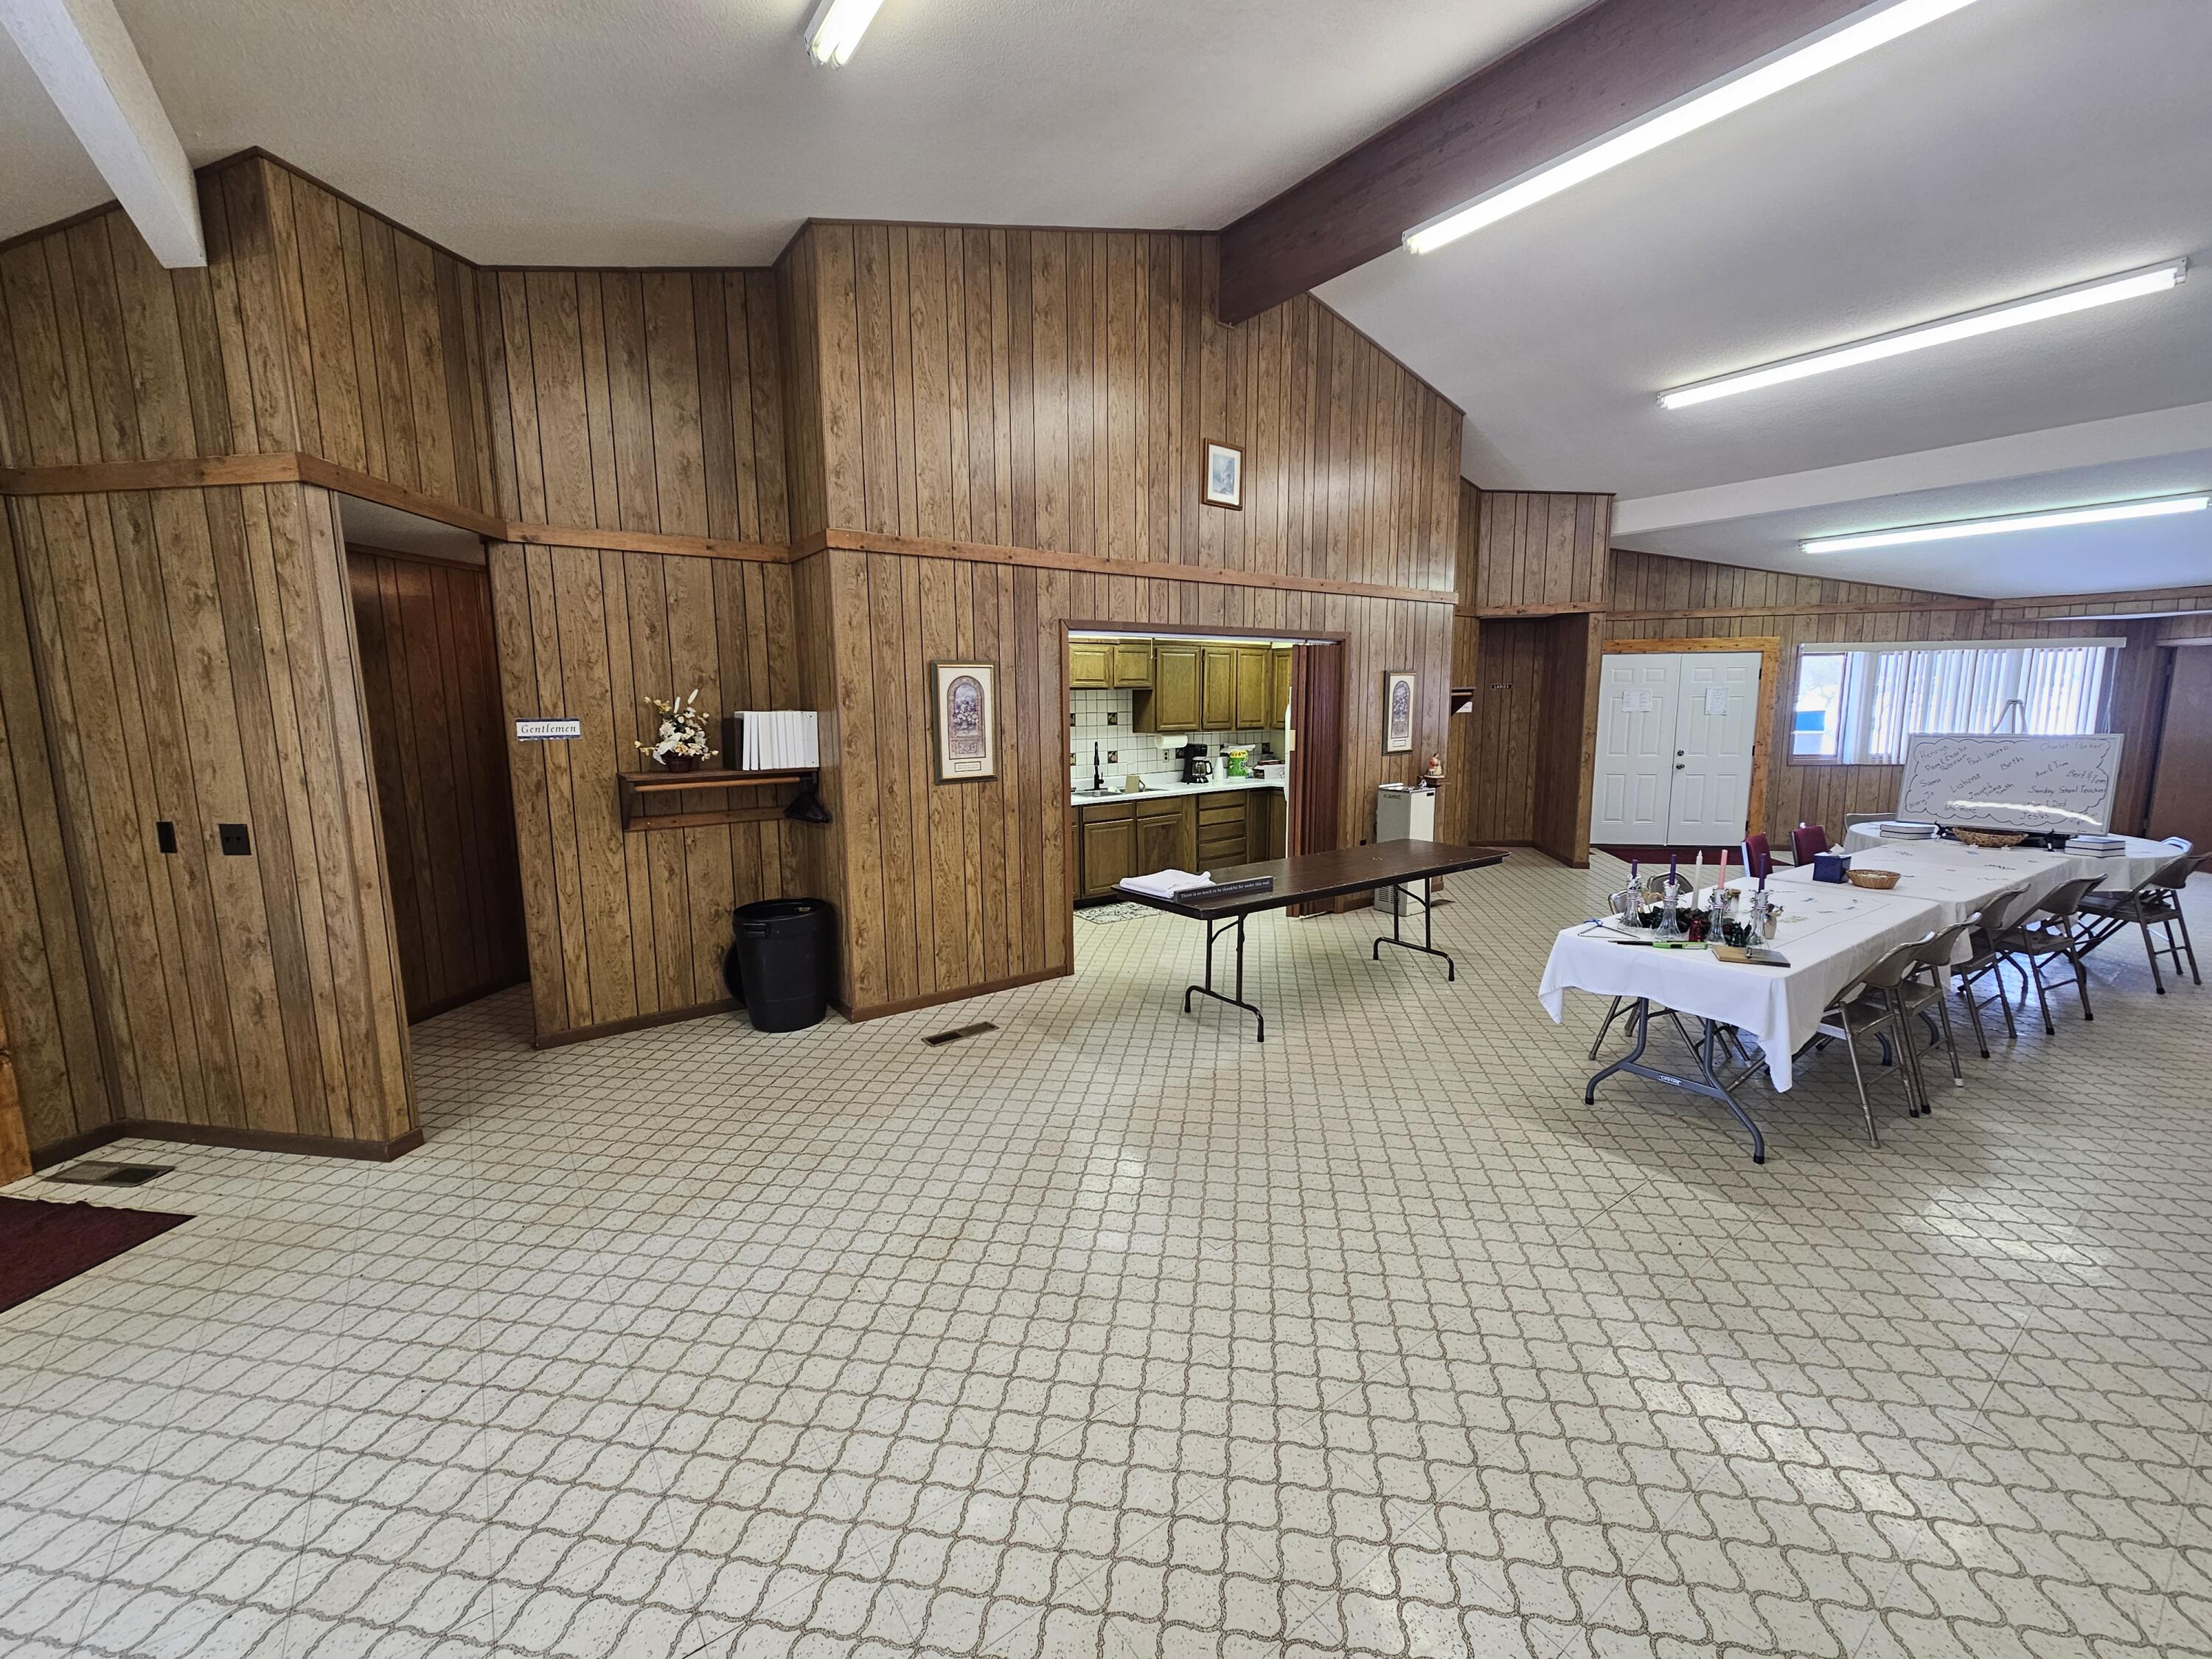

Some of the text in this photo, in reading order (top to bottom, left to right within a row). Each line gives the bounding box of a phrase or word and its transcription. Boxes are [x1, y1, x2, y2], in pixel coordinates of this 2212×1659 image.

[521, 723, 576, 733] Gentlemen
[2028, 785, 2055, 795] Sunday
[2059, 785, 2078, 793] School
[2052, 799, 2067, 807] Dad
[2020, 812, 2049, 820] Jesus
